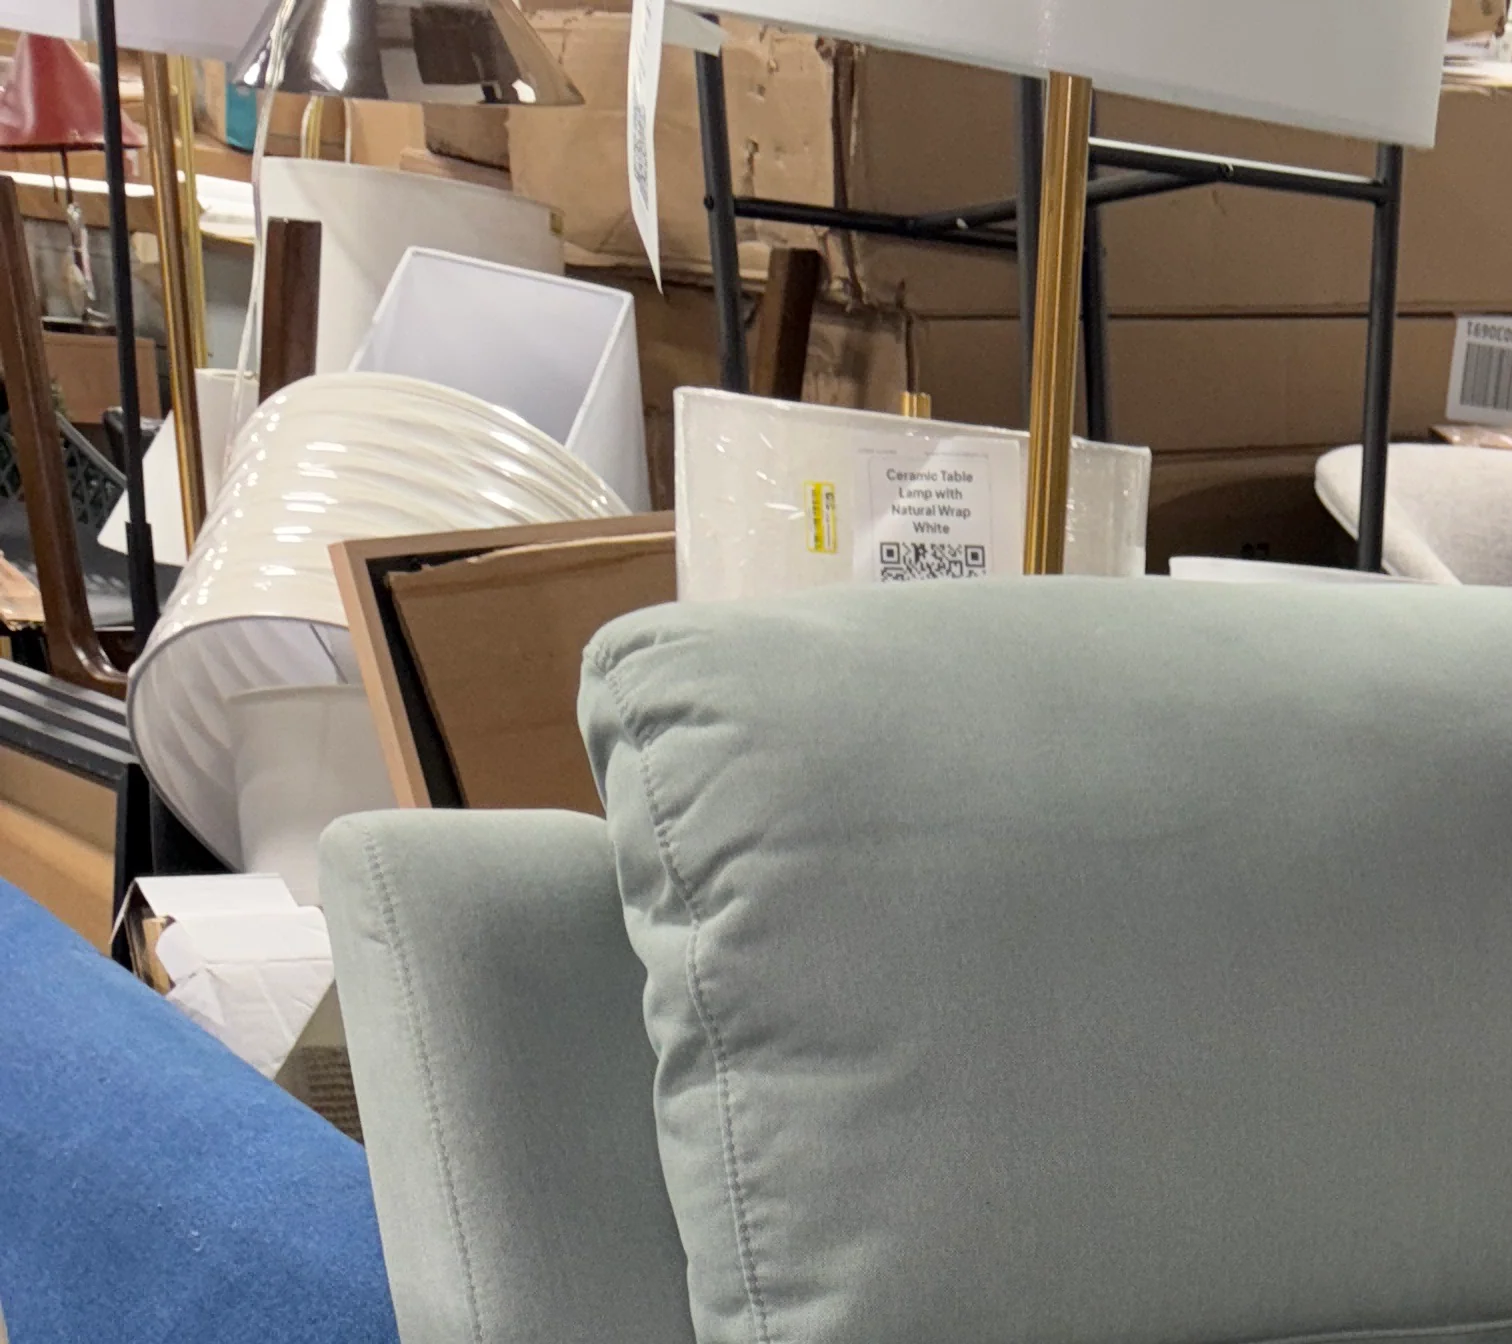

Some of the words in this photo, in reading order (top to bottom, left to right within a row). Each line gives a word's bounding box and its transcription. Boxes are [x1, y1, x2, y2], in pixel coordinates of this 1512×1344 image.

[886, 468, 938, 483] Ceramic
[940, 469, 974, 484] Table
[899, 487, 932, 500] Lamp
[935, 488, 963, 500] with
[891, 504, 936, 517] Natural
[938, 505, 971, 518] Wrap
[912, 521, 951, 534] White
